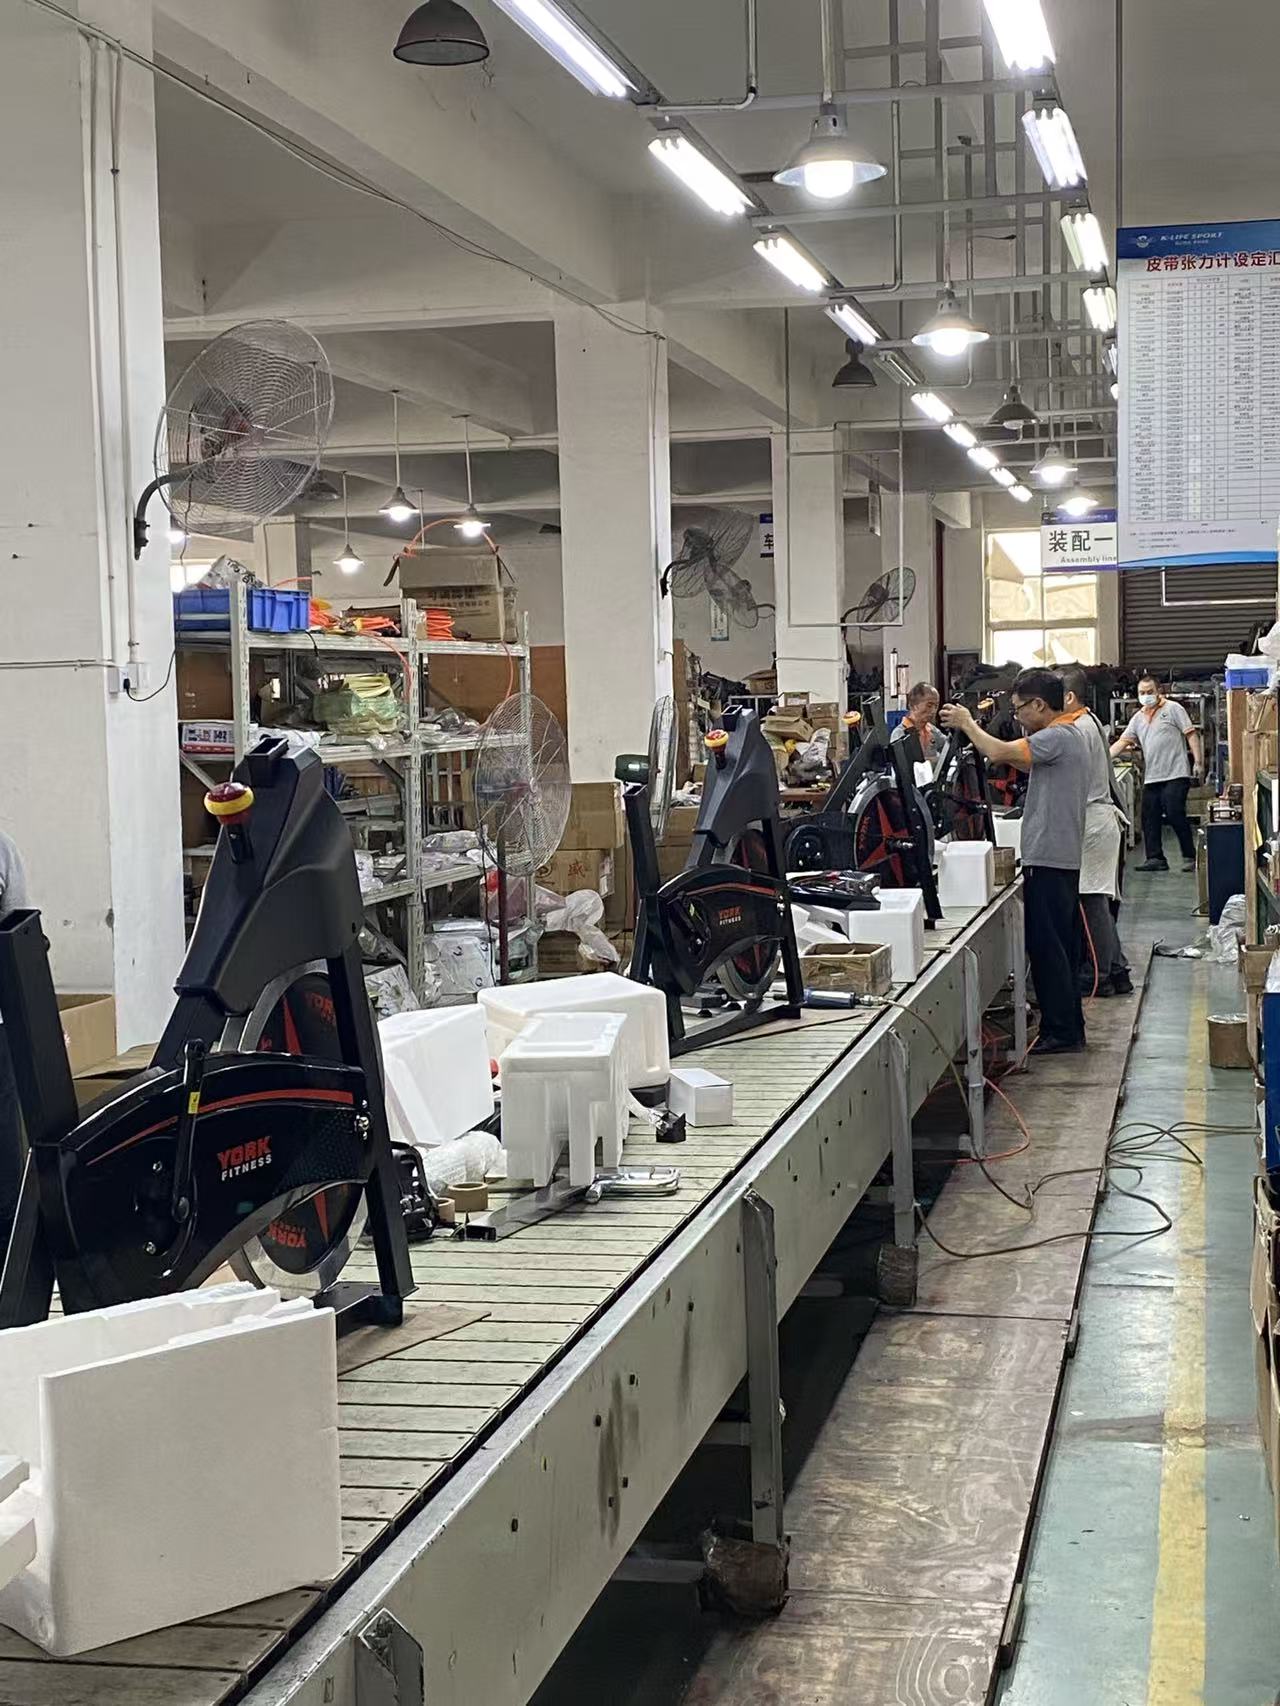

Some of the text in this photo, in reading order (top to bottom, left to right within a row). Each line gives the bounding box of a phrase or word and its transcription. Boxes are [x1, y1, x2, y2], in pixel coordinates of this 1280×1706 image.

[1049, 530, 1113, 552] 装配一
[217, 1135, 272, 1170] YORK
[221, 1154, 273, 1182] FITNESS
